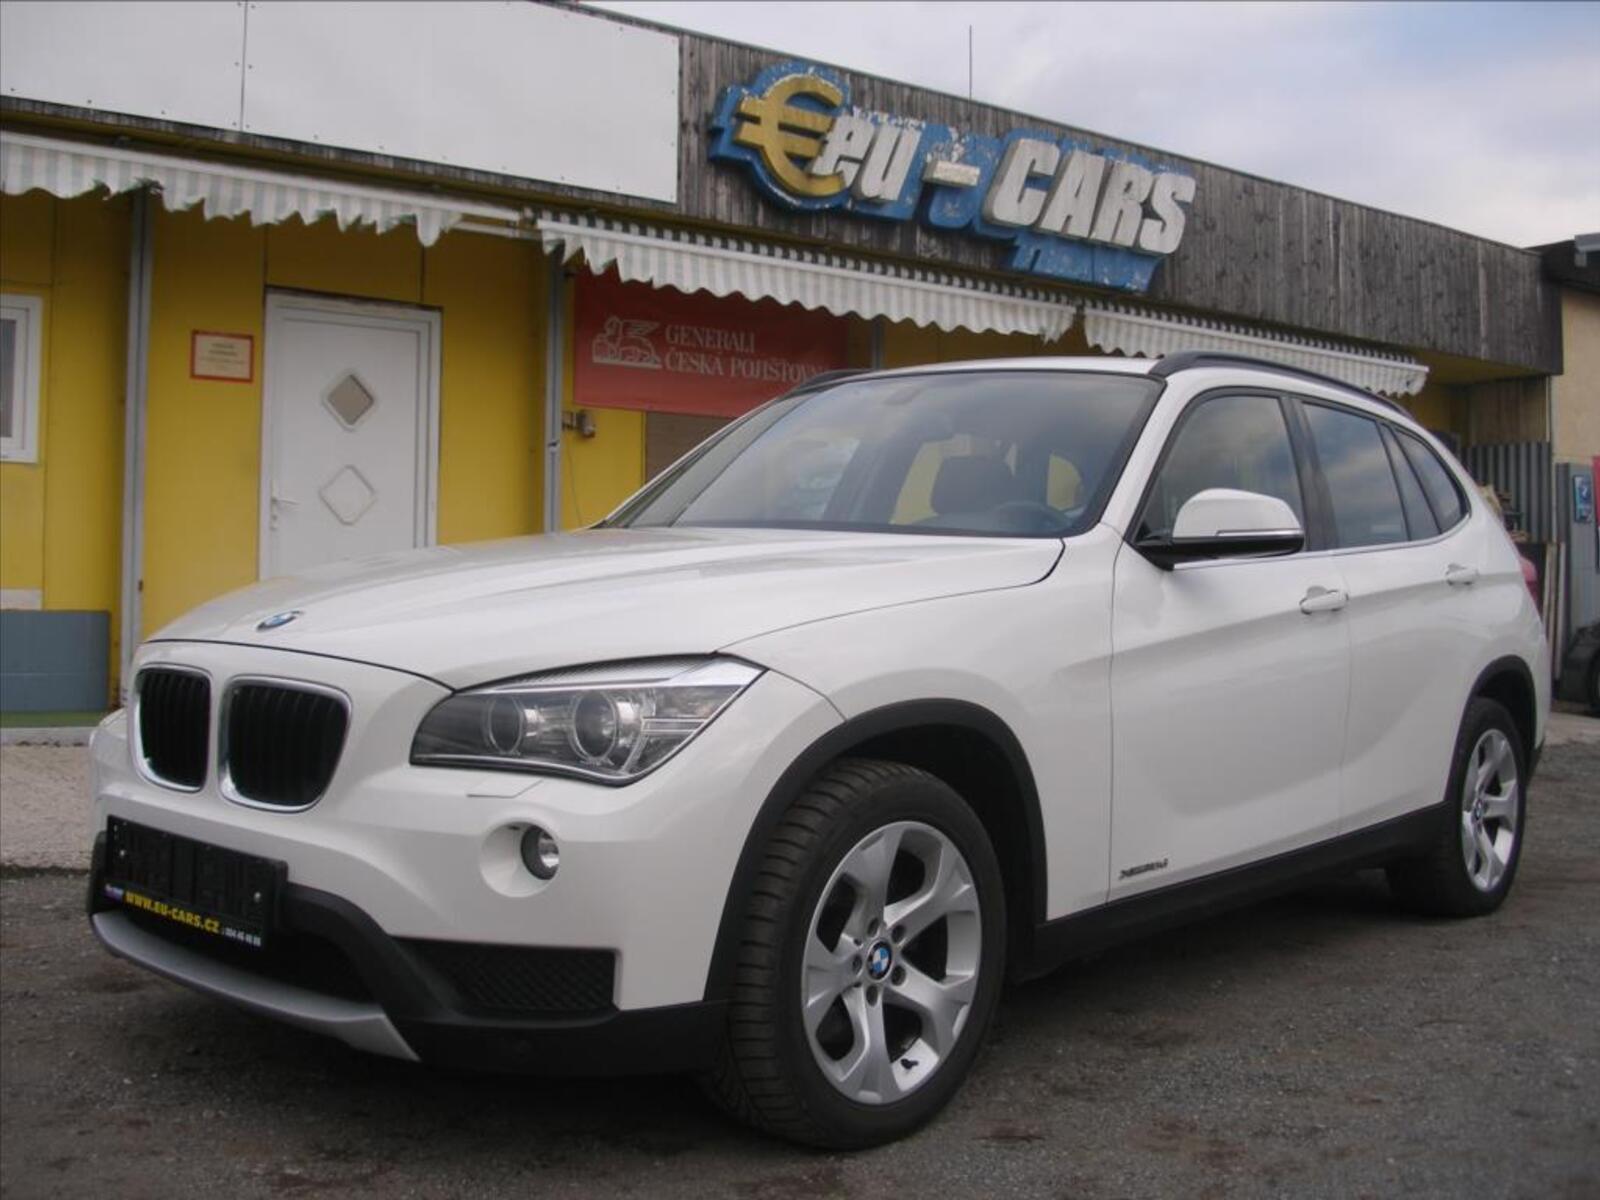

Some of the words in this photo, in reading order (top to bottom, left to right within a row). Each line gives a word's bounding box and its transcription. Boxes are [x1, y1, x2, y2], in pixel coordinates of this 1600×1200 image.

[984, 138, 1197, 255] CARS
[664, 324, 755, 354] GENERALI
[125, 890, 220, 934] WWW.EU-CARS.CZ
